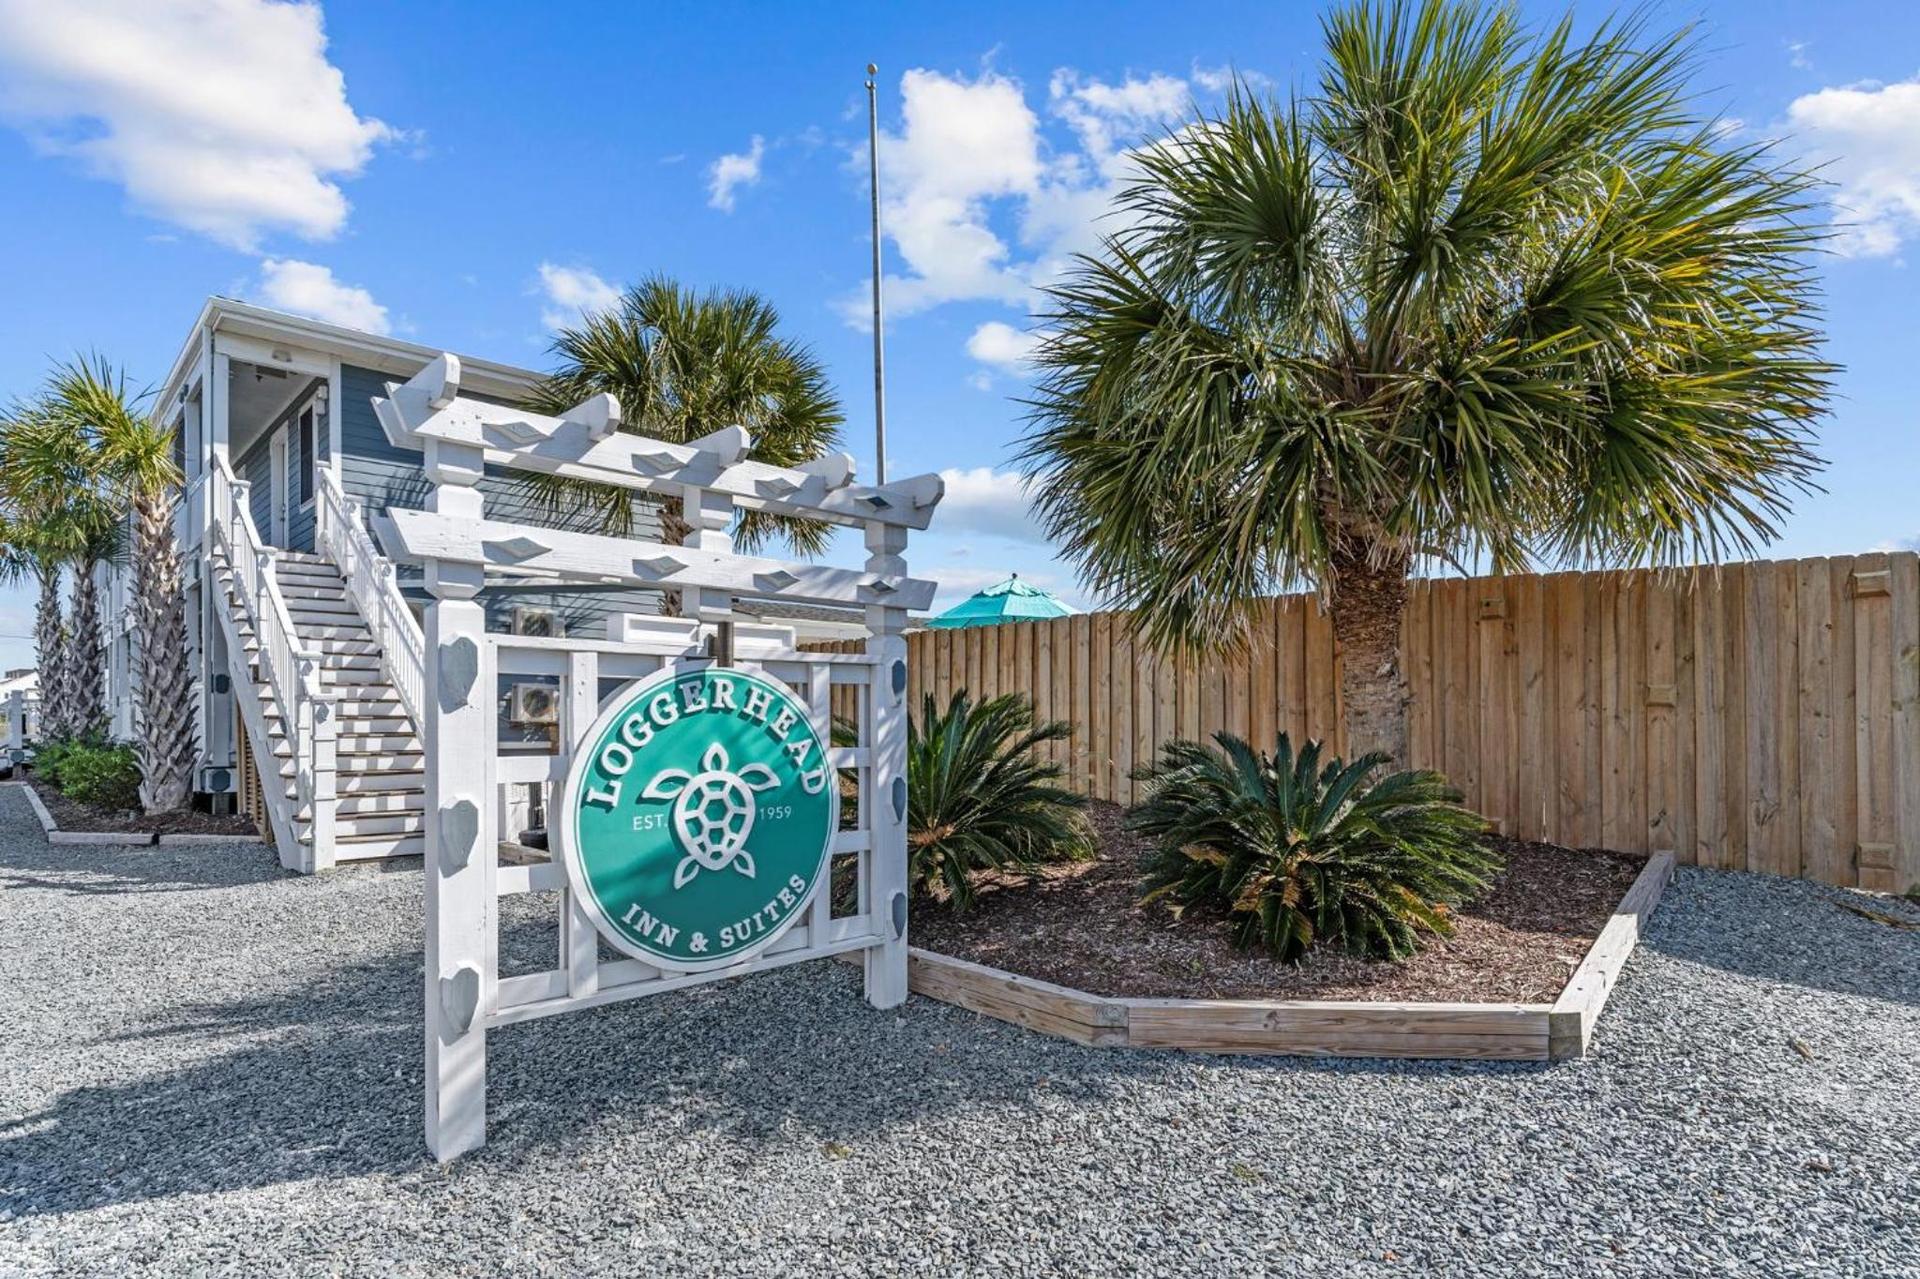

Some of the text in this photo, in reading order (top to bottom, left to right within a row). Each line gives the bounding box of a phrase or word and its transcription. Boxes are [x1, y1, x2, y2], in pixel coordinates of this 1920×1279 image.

[586, 678, 826, 807] LOGGERHEAD
[632, 806, 792, 831] EST. 1959
[621, 874, 806, 952] INN & SUITES
